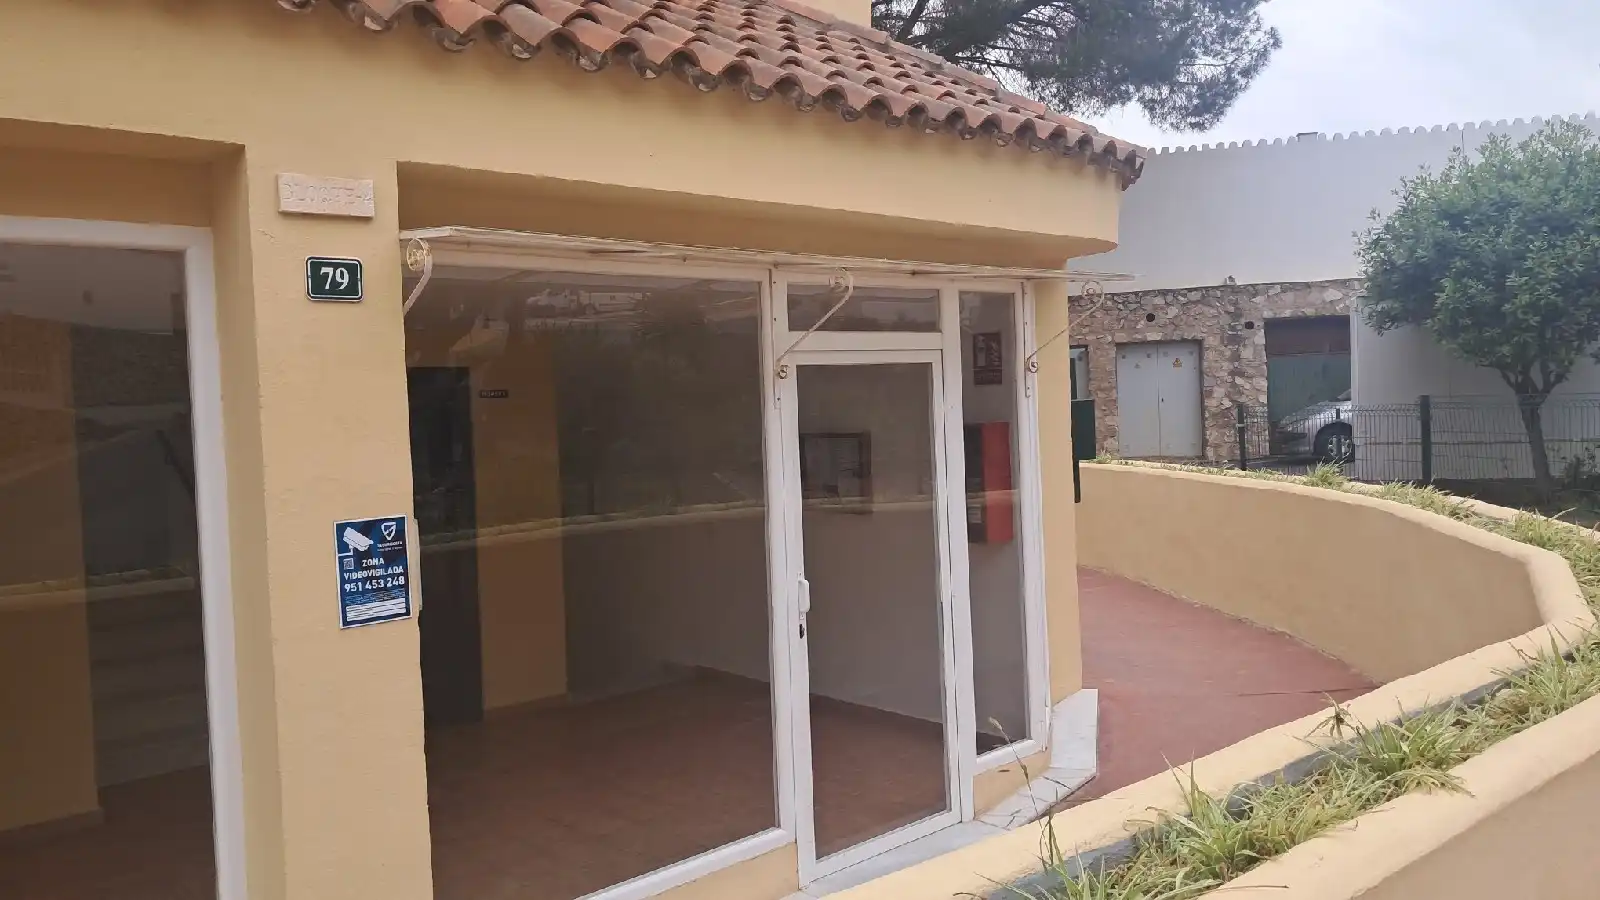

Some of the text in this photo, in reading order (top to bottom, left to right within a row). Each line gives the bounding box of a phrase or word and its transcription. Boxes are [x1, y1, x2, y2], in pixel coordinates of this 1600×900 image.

[320, 266, 349, 290] 79
[362, 557, 385, 567] ZONA
[343, 565, 404, 581] VIDEOVIGILADA
[344, 575, 405, 593] 951 453 248
